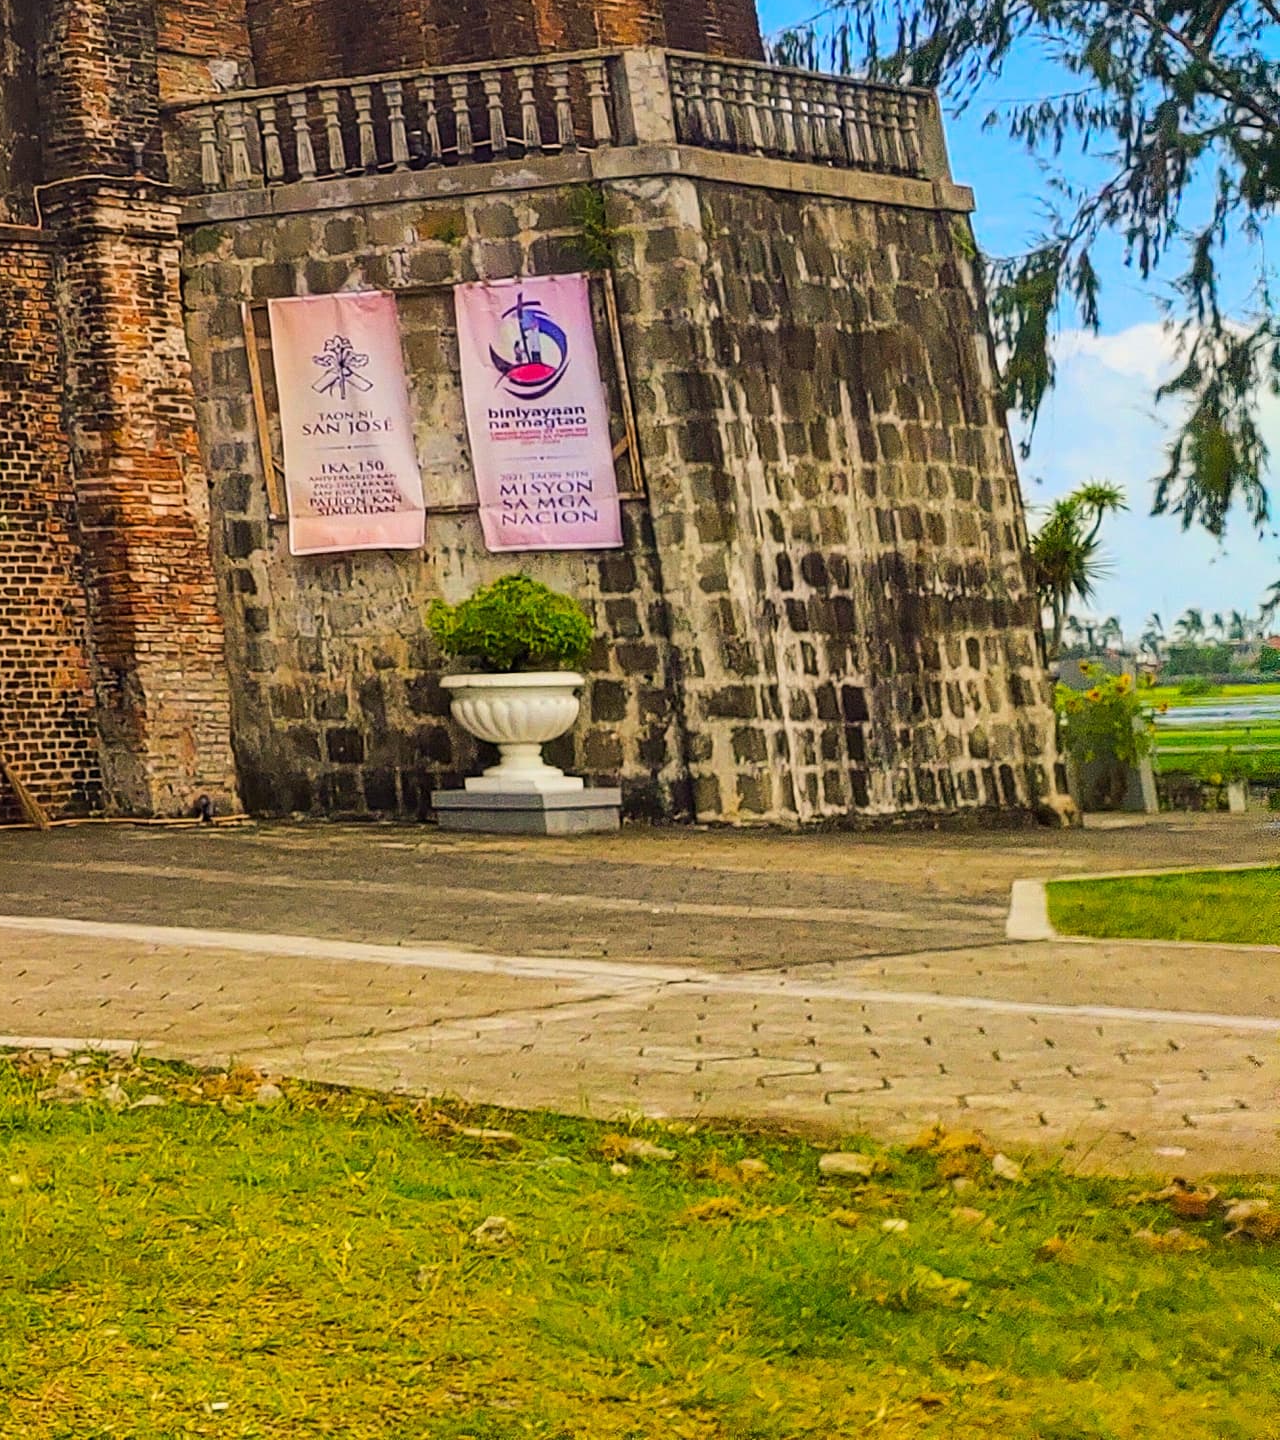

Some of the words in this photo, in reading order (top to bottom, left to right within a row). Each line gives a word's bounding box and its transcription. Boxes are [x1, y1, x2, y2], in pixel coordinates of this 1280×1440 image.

[319, 411, 354, 421] TAON
[359, 410, 373, 419] NI
[488, 406, 585, 419] biniyayaan
[302, 422, 340, 436] SAN
[489, 421, 510, 429] na
[515, 417, 587, 428] magtao
[500, 479, 593, 496] MISYON
[309, 496, 366, 507] PATRON
[373, 494, 402, 504] KAN
[502, 498, 528, 511] SA
[538, 494, 590, 509] MGA
[502, 509, 598, 526] NACION
